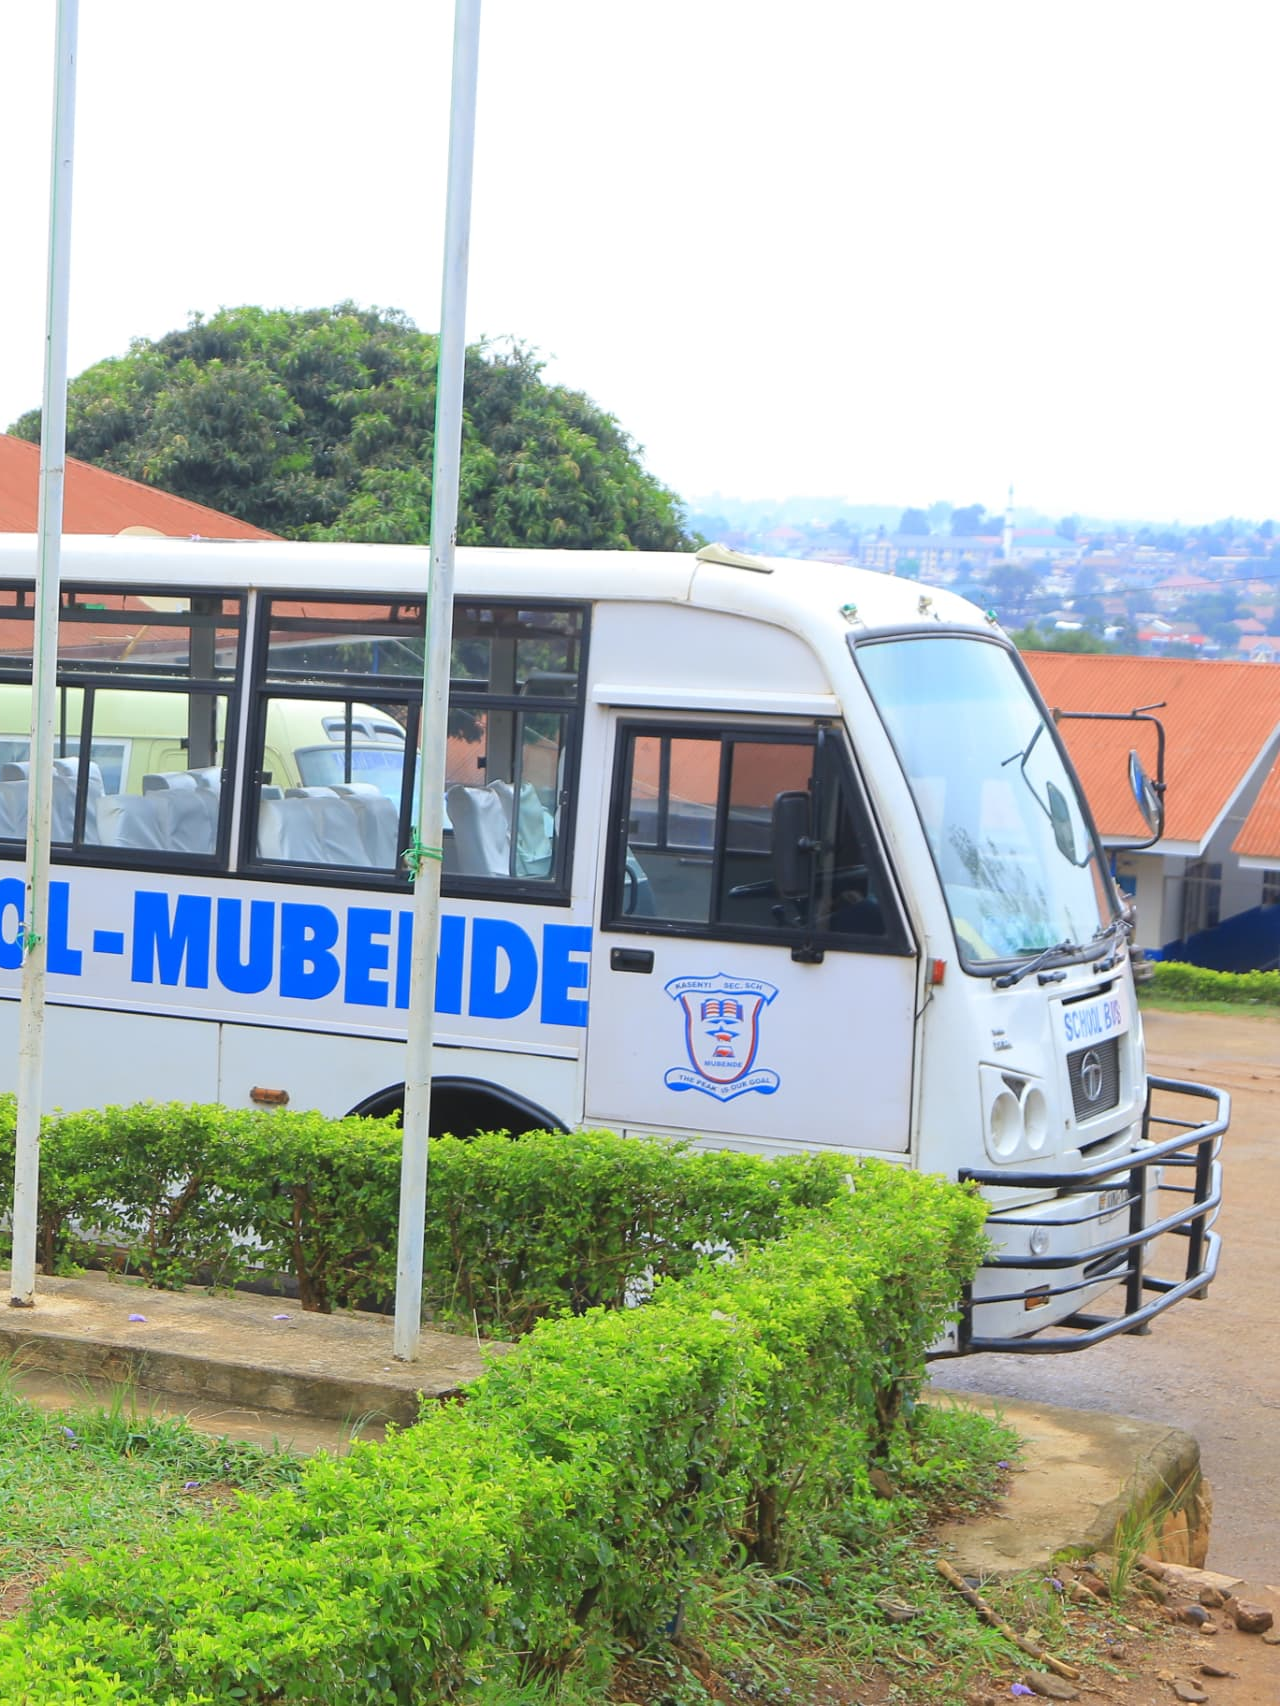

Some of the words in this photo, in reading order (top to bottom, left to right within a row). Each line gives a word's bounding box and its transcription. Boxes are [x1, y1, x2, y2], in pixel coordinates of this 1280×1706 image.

[675, 981, 712, 989] KASENYI
[1064, 1005, 1103, 1041] SCHOOL
[1103, 1000, 1122, 1030] BUS
[703, 1060, 743, 1068] MUBENDE
[679, 1074, 695, 1083] THE
